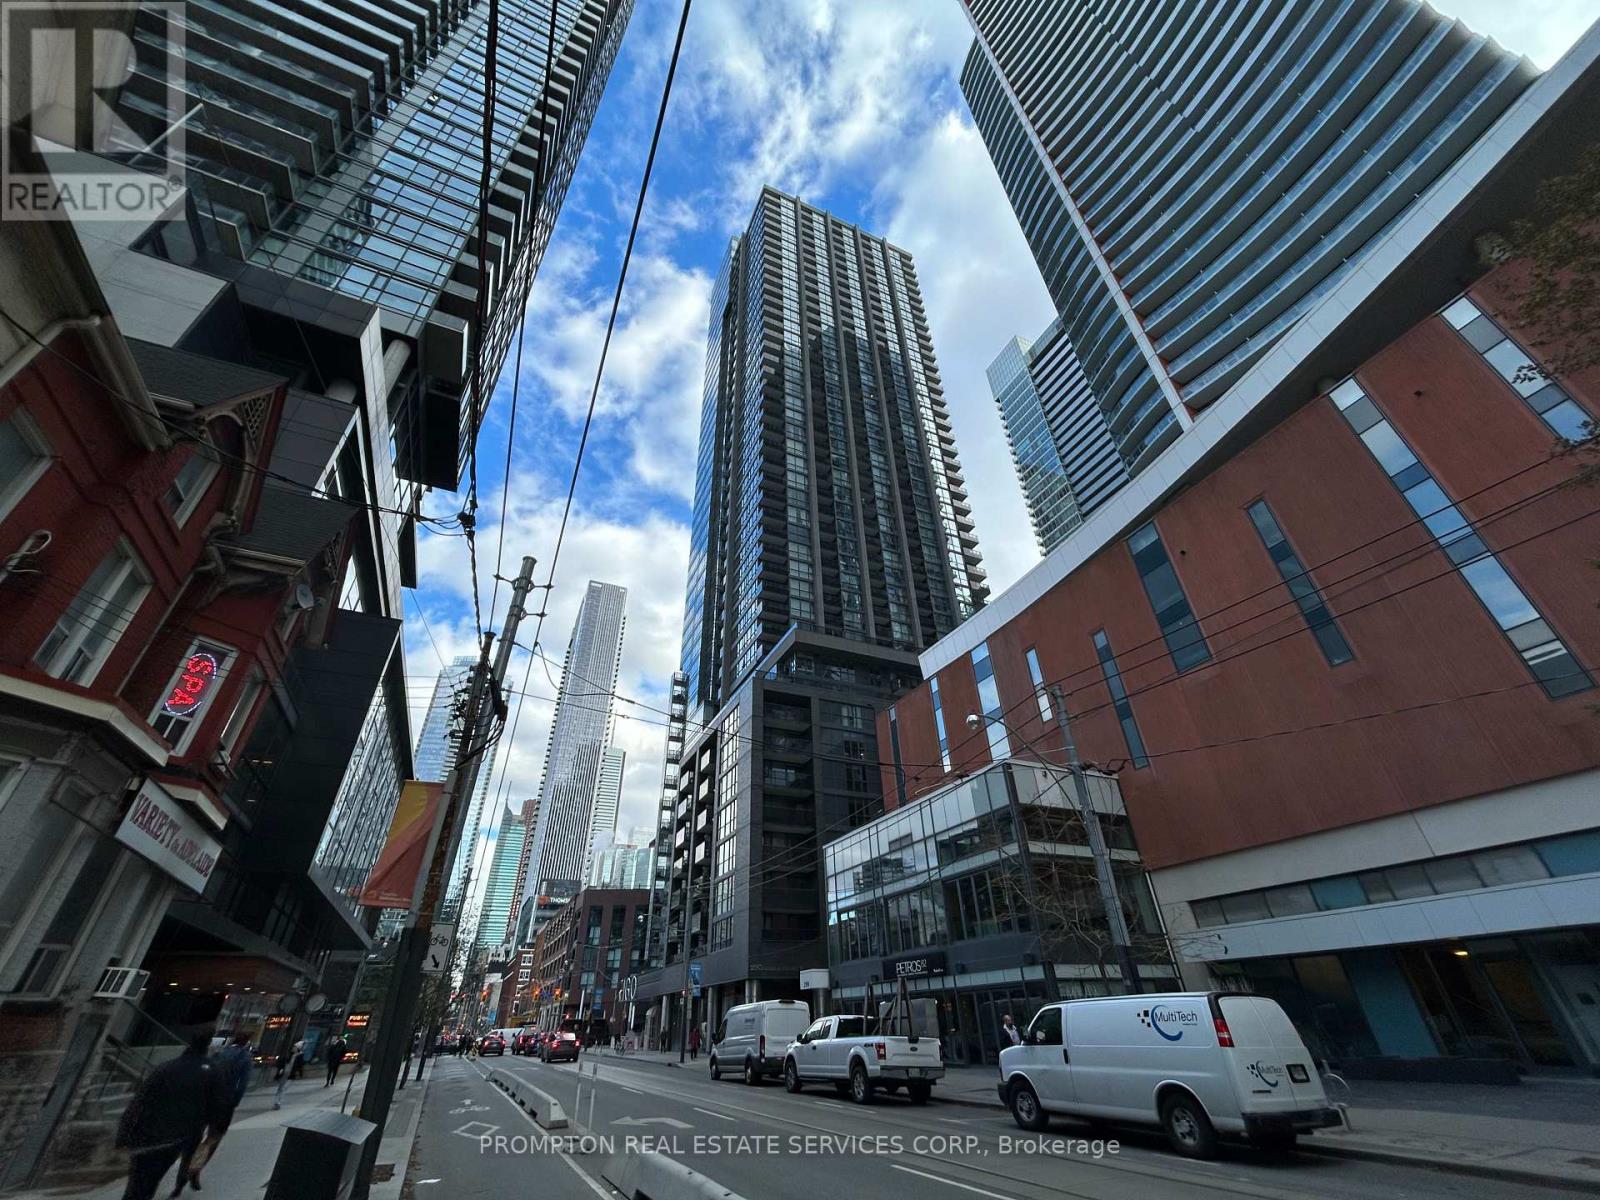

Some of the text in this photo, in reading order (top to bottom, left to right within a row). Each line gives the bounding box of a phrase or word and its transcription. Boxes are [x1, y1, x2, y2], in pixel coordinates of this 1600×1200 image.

[167, 656, 213, 705] SPA
[129, 793, 183, 849] VARIETY
[1154, 1010, 1198, 1022] MultiTech
